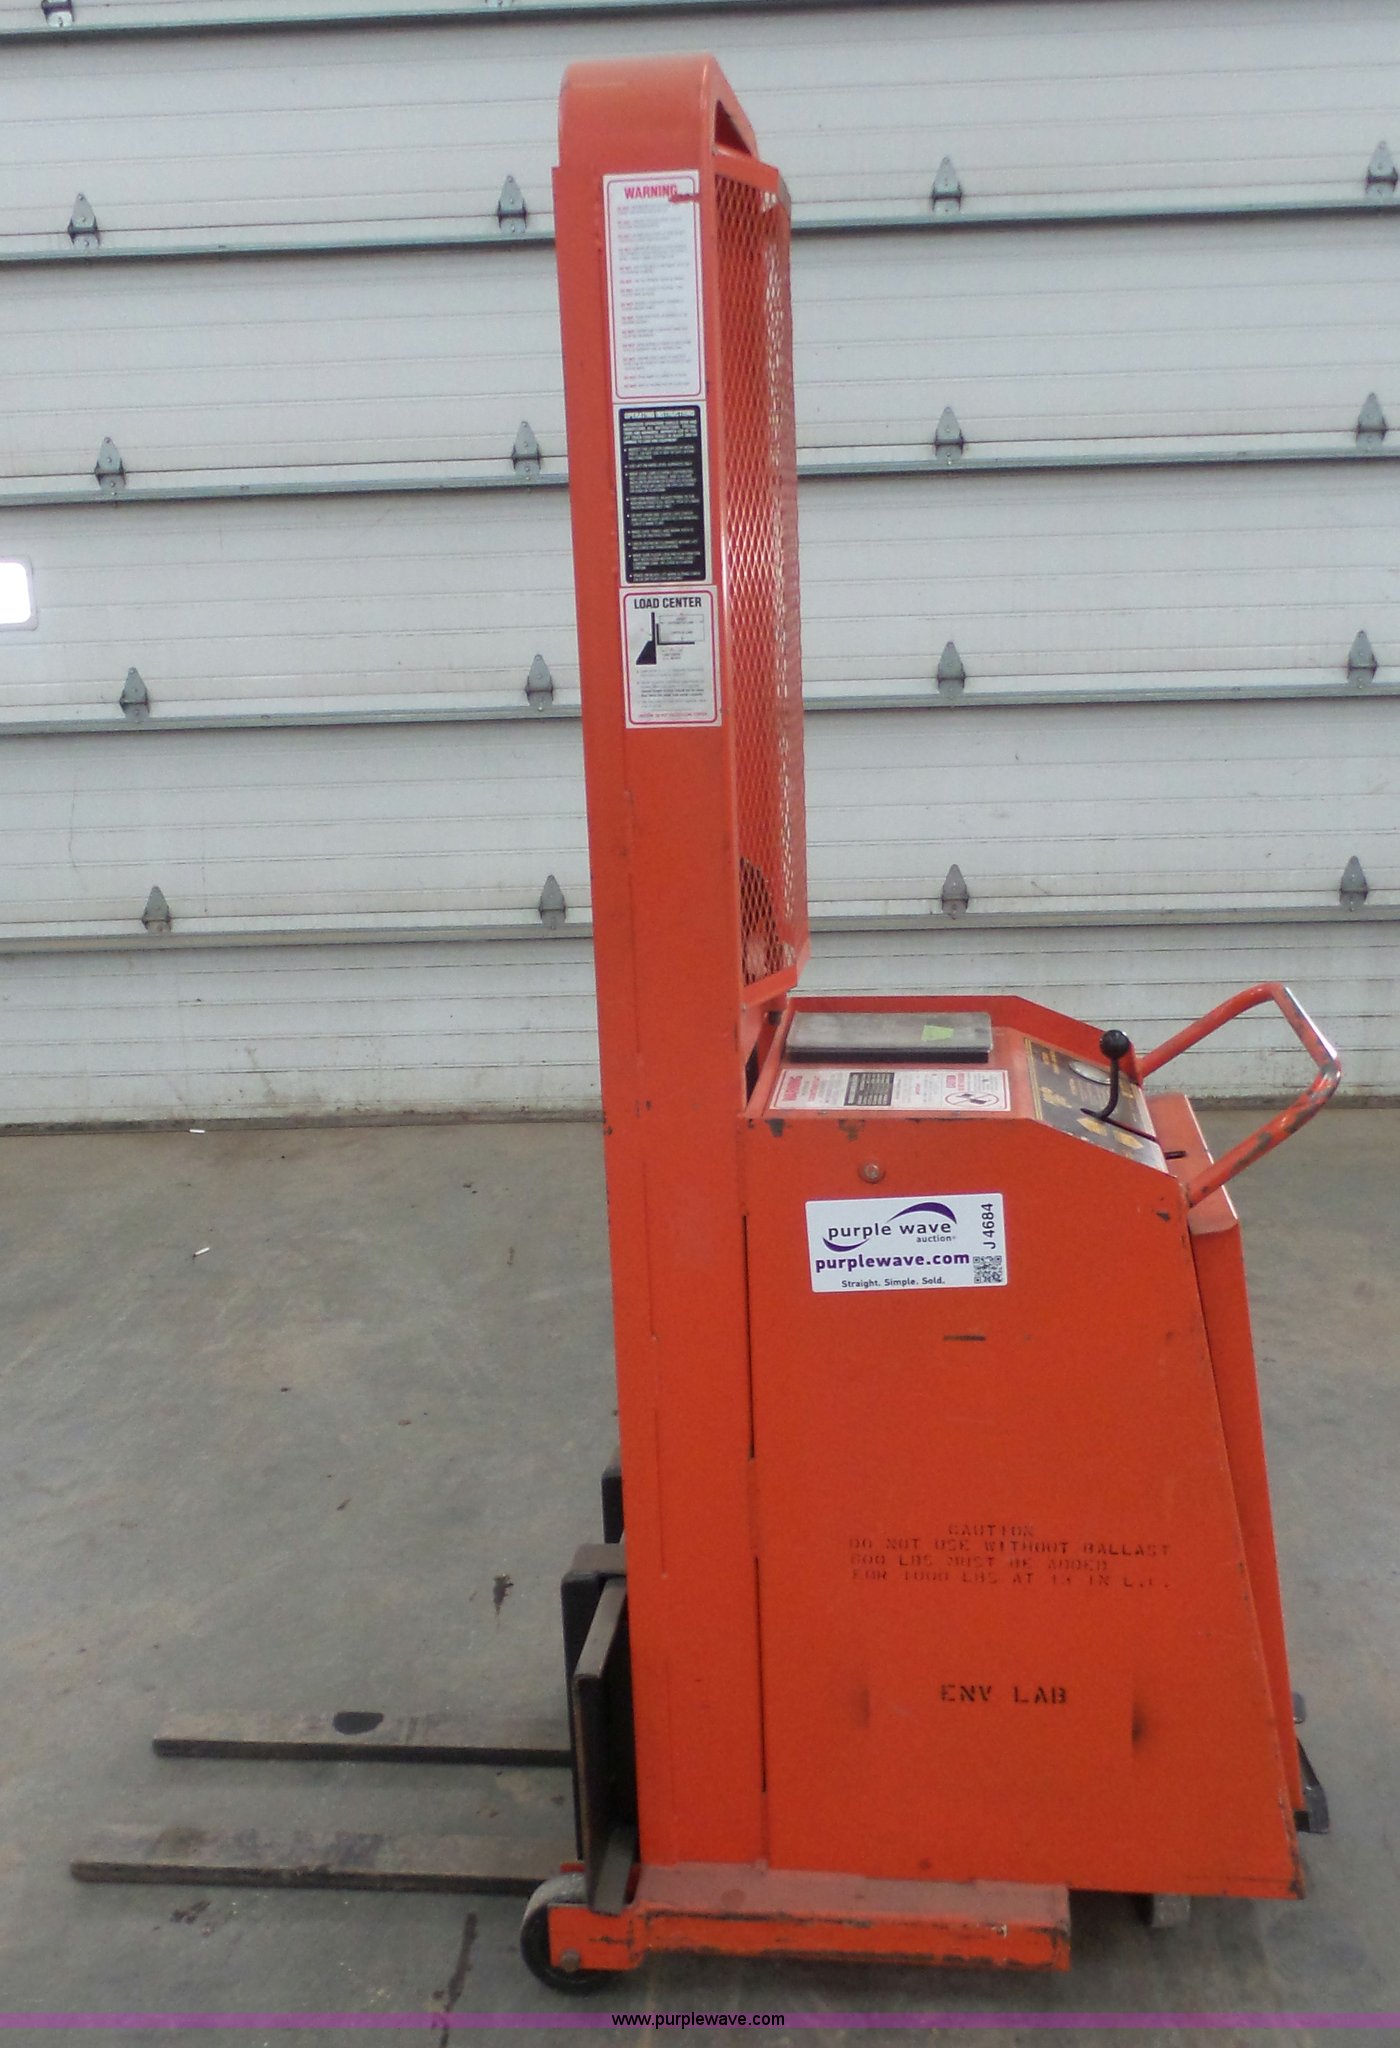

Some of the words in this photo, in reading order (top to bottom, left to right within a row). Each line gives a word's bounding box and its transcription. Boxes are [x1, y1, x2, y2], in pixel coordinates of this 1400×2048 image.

[624, 184, 677, 199] WARNING
[634, 598, 660, 609] LOAD
[662, 597, 702, 608] CENTER
[981, 1203, 995, 1238] 4684
[828, 1223, 891, 1240] purple
[899, 1222, 951, 1235] wave
[916, 1234, 952, 1243] auction
[983, 1241, 996, 1250] J
[815, 1252, 970, 1273] purplewave.com
[841, 1278, 881, 1288] Straight.
[884, 1277, 919, 1287] Simple.
[922, 1276, 945, 1285] Sold.
[948, 1523, 1034, 1538] CAUTION
[849, 1537, 873, 1549] DO
[886, 1538, 921, 1550] NOT
[934, 1538, 970, 1552] USE
[984, 1540, 1069, 1554] WITHOUT
[1083, 1542, 1171, 1557] BALLAST
[898, 1554, 933, 1567] LBS
[852, 1568, 887, 1581] FOR
[961, 1571, 998, 1584] LBS
[1012, 1572, 1034, 1585] AT
[941, 1684, 993, 1702] ENV
[1013, 1685, 1068, 1704] LAB
